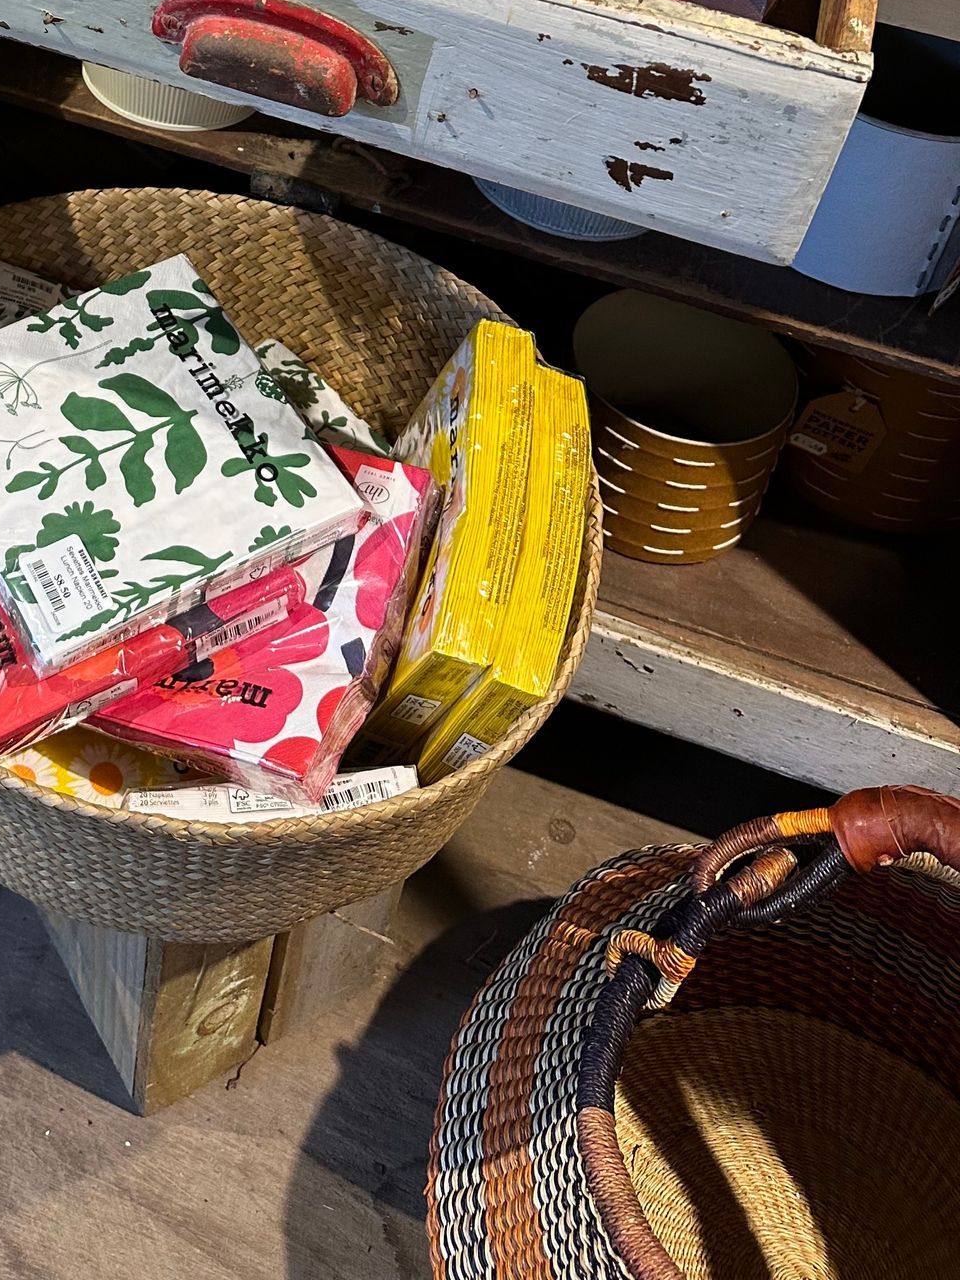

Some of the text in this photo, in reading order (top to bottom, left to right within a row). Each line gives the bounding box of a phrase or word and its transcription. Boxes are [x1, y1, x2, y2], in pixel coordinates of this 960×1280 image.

[150, 303, 279, 482] marimekko
[807, 414, 869, 446] PAPER
[53, 572, 71, 599] $8.50
[59, 554, 92, 610] Lunch Napkin 20
[81, 574, 104, 611] Marimekko
